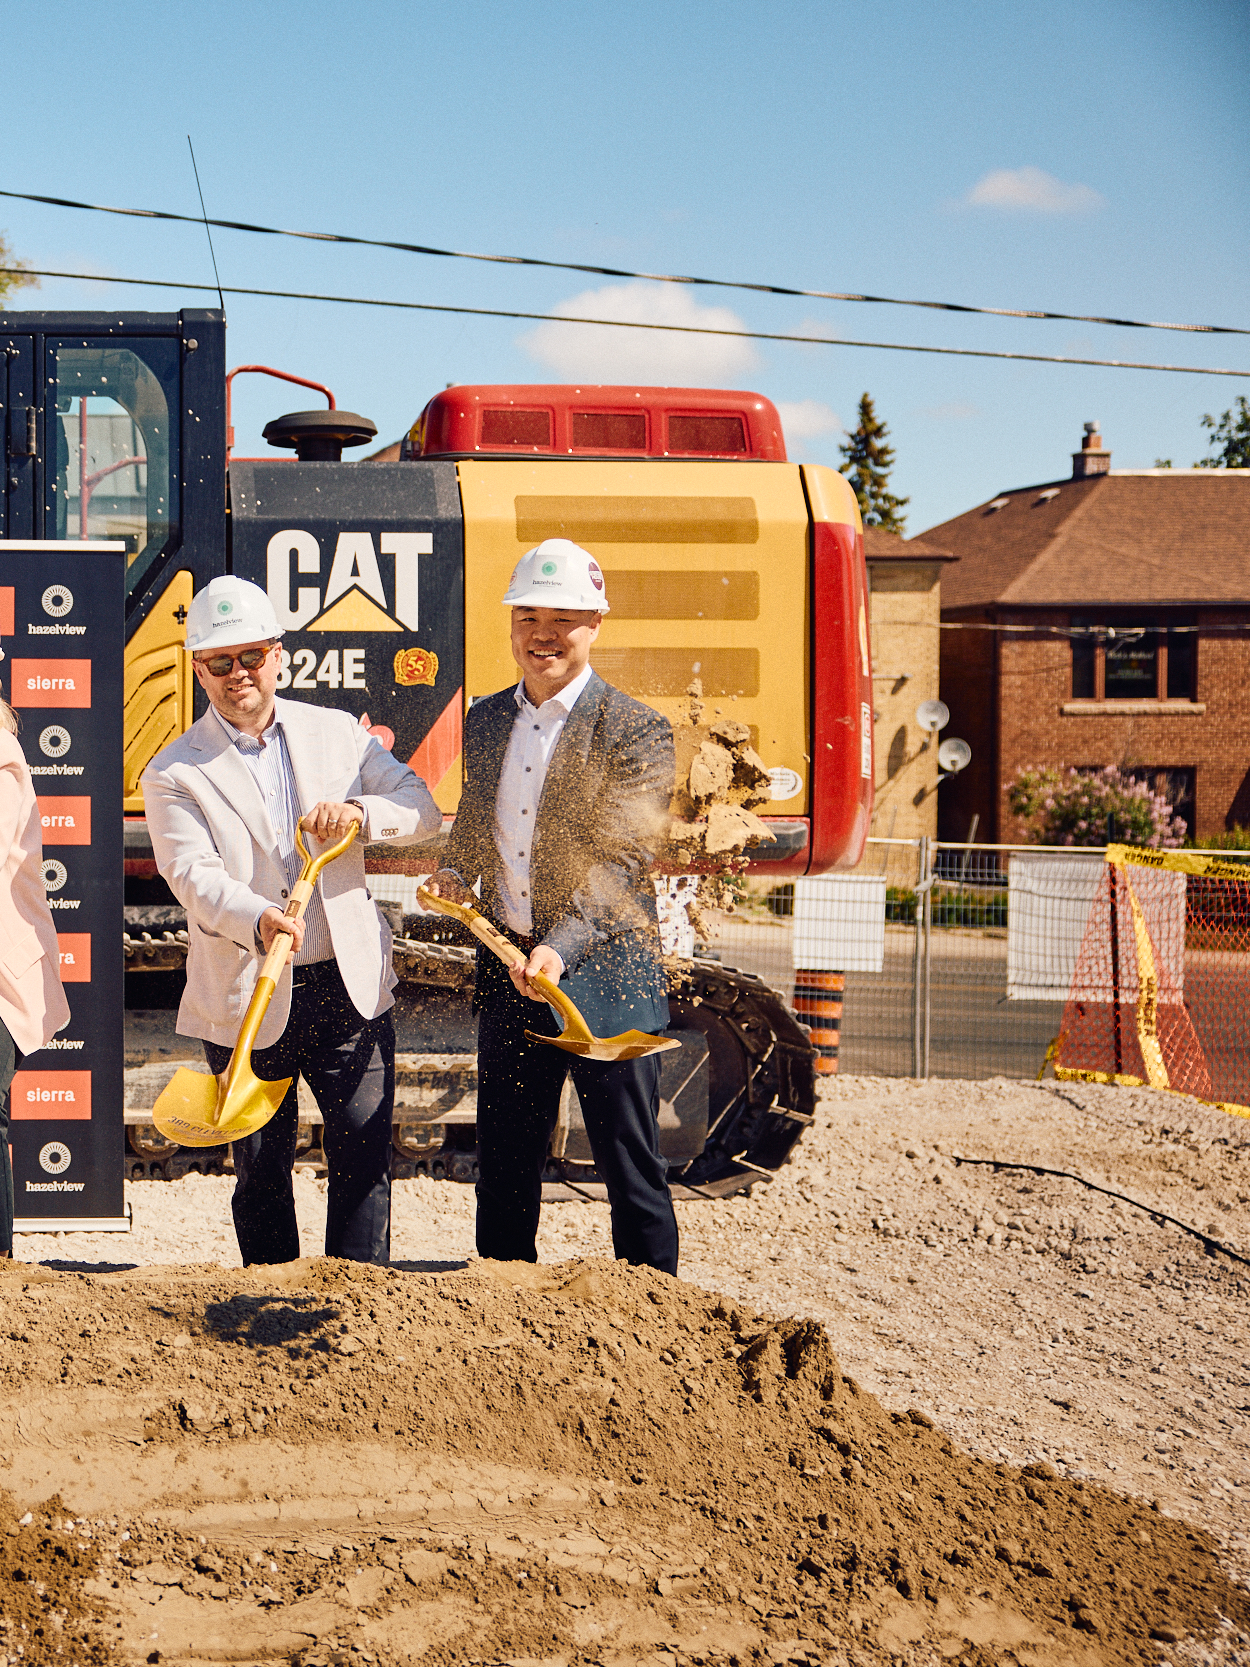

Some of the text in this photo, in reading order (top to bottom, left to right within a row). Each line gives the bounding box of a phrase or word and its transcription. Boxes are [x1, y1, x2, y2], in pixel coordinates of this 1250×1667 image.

[266, 529, 434, 632] CAT
[28, 623, 86, 635] hazelview
[407, 656, 425, 675] 55
[27, 675, 75, 690] sierra
[40, 814, 76, 827] erra
[47, 898, 81, 909] lview
[40, 1038, 84, 1050] elview
[26, 1088, 75, 1103] sierra
[167, 1116, 191, 1129] 389
[26, 1181, 85, 1192] hazelview
